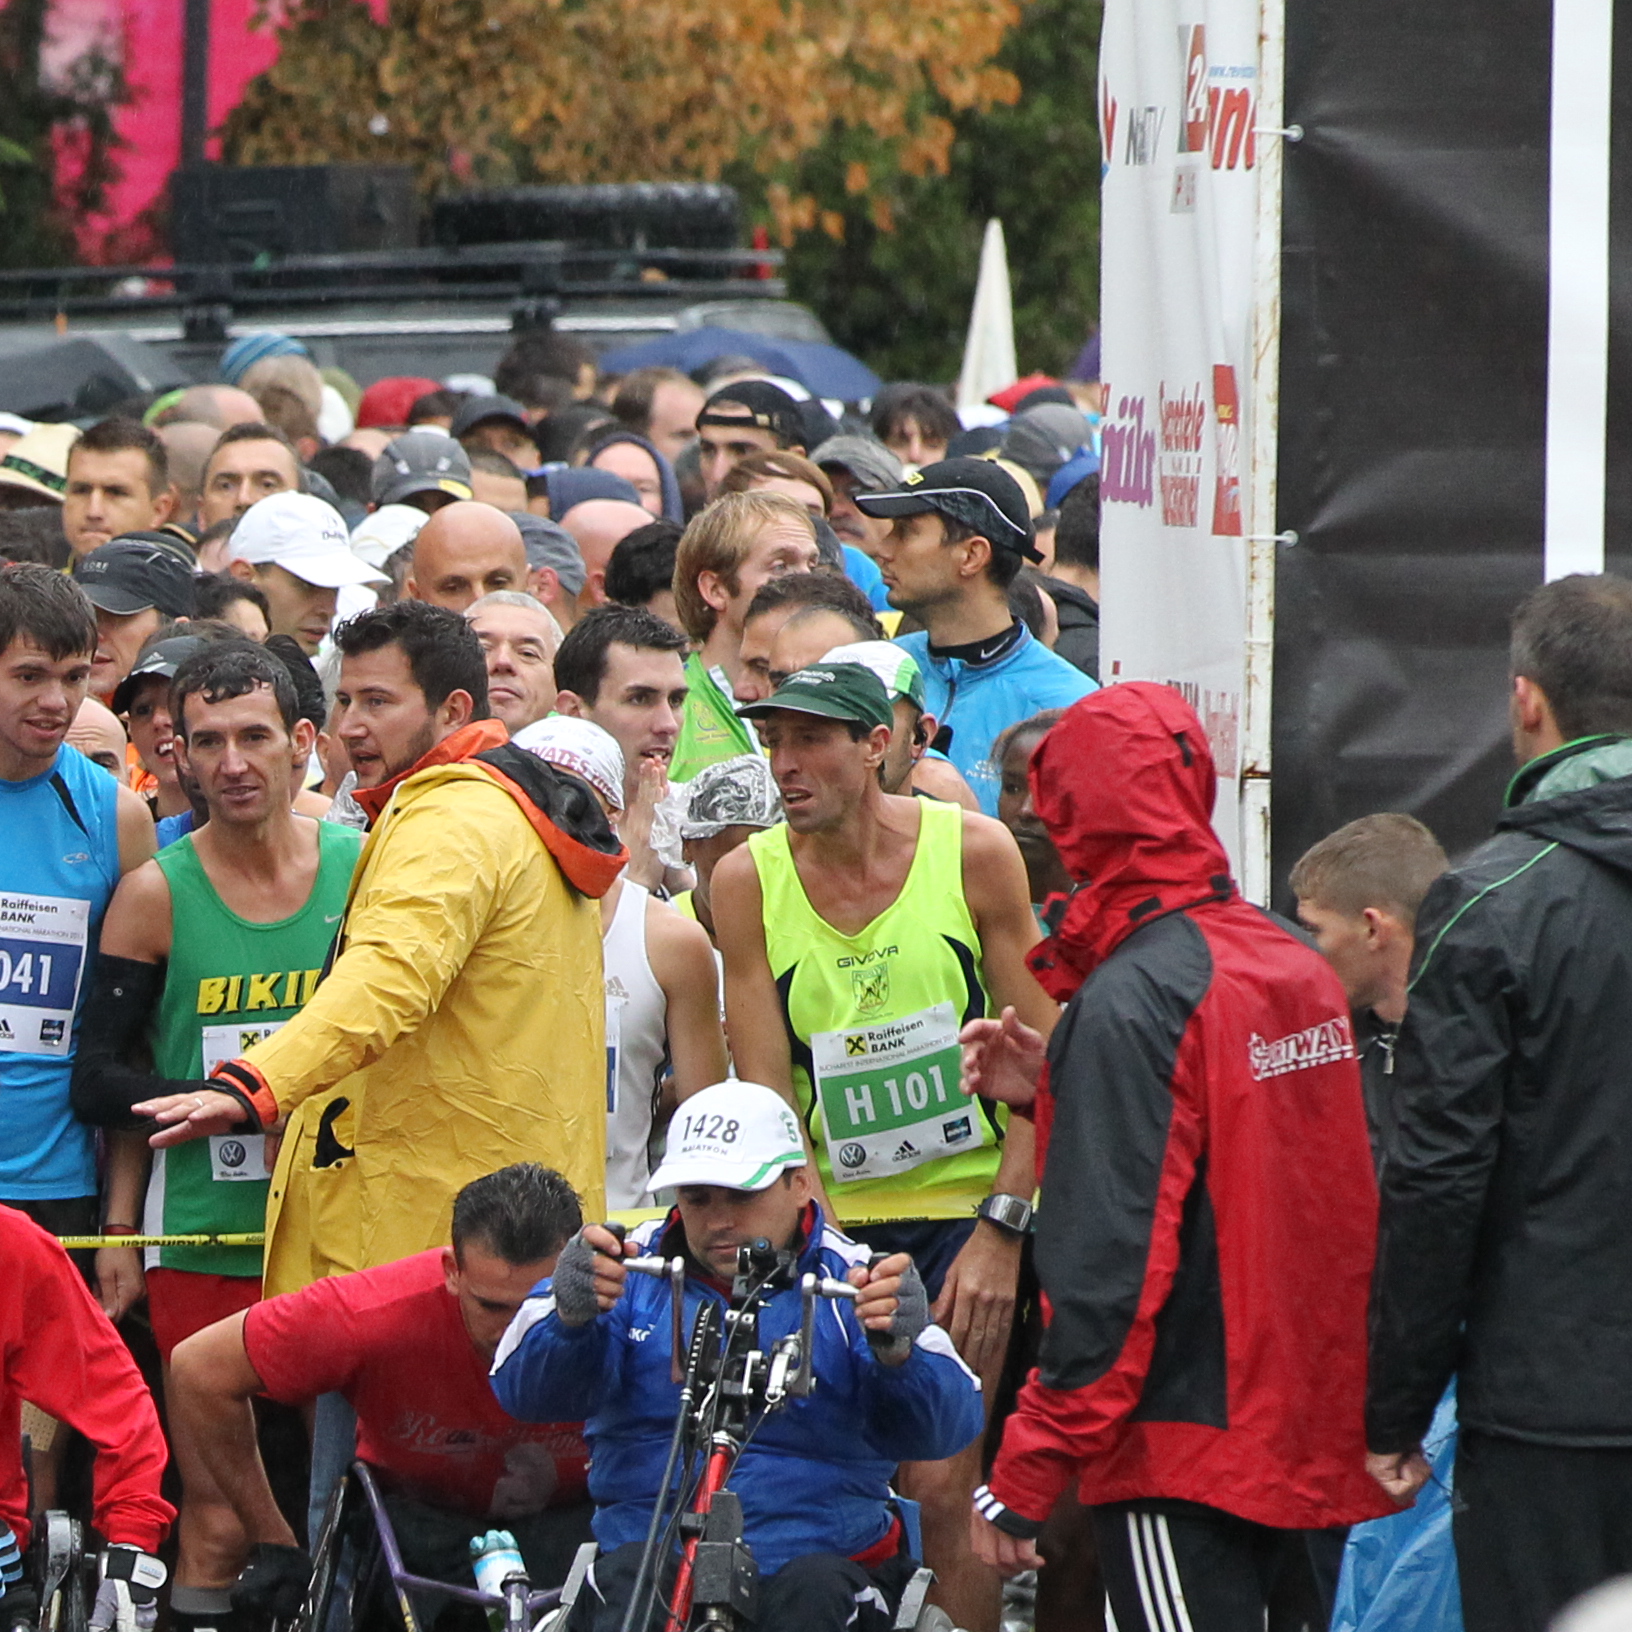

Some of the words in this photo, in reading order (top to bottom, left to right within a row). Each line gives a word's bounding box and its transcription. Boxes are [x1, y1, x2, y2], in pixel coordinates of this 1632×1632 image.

[0, 911, 37, 924] BANK
[1, 899, 58, 914] Raiffeisen
[837, 946, 899, 968] GIVOVA
[867, 1020, 925, 1042] Raiffeisen
[871, 1037, 906, 1053] BANK
[844, 1085, 877, 1125] H
[883, 1064, 948, 1116] 101
[683, 1114, 740, 1144] 1428
